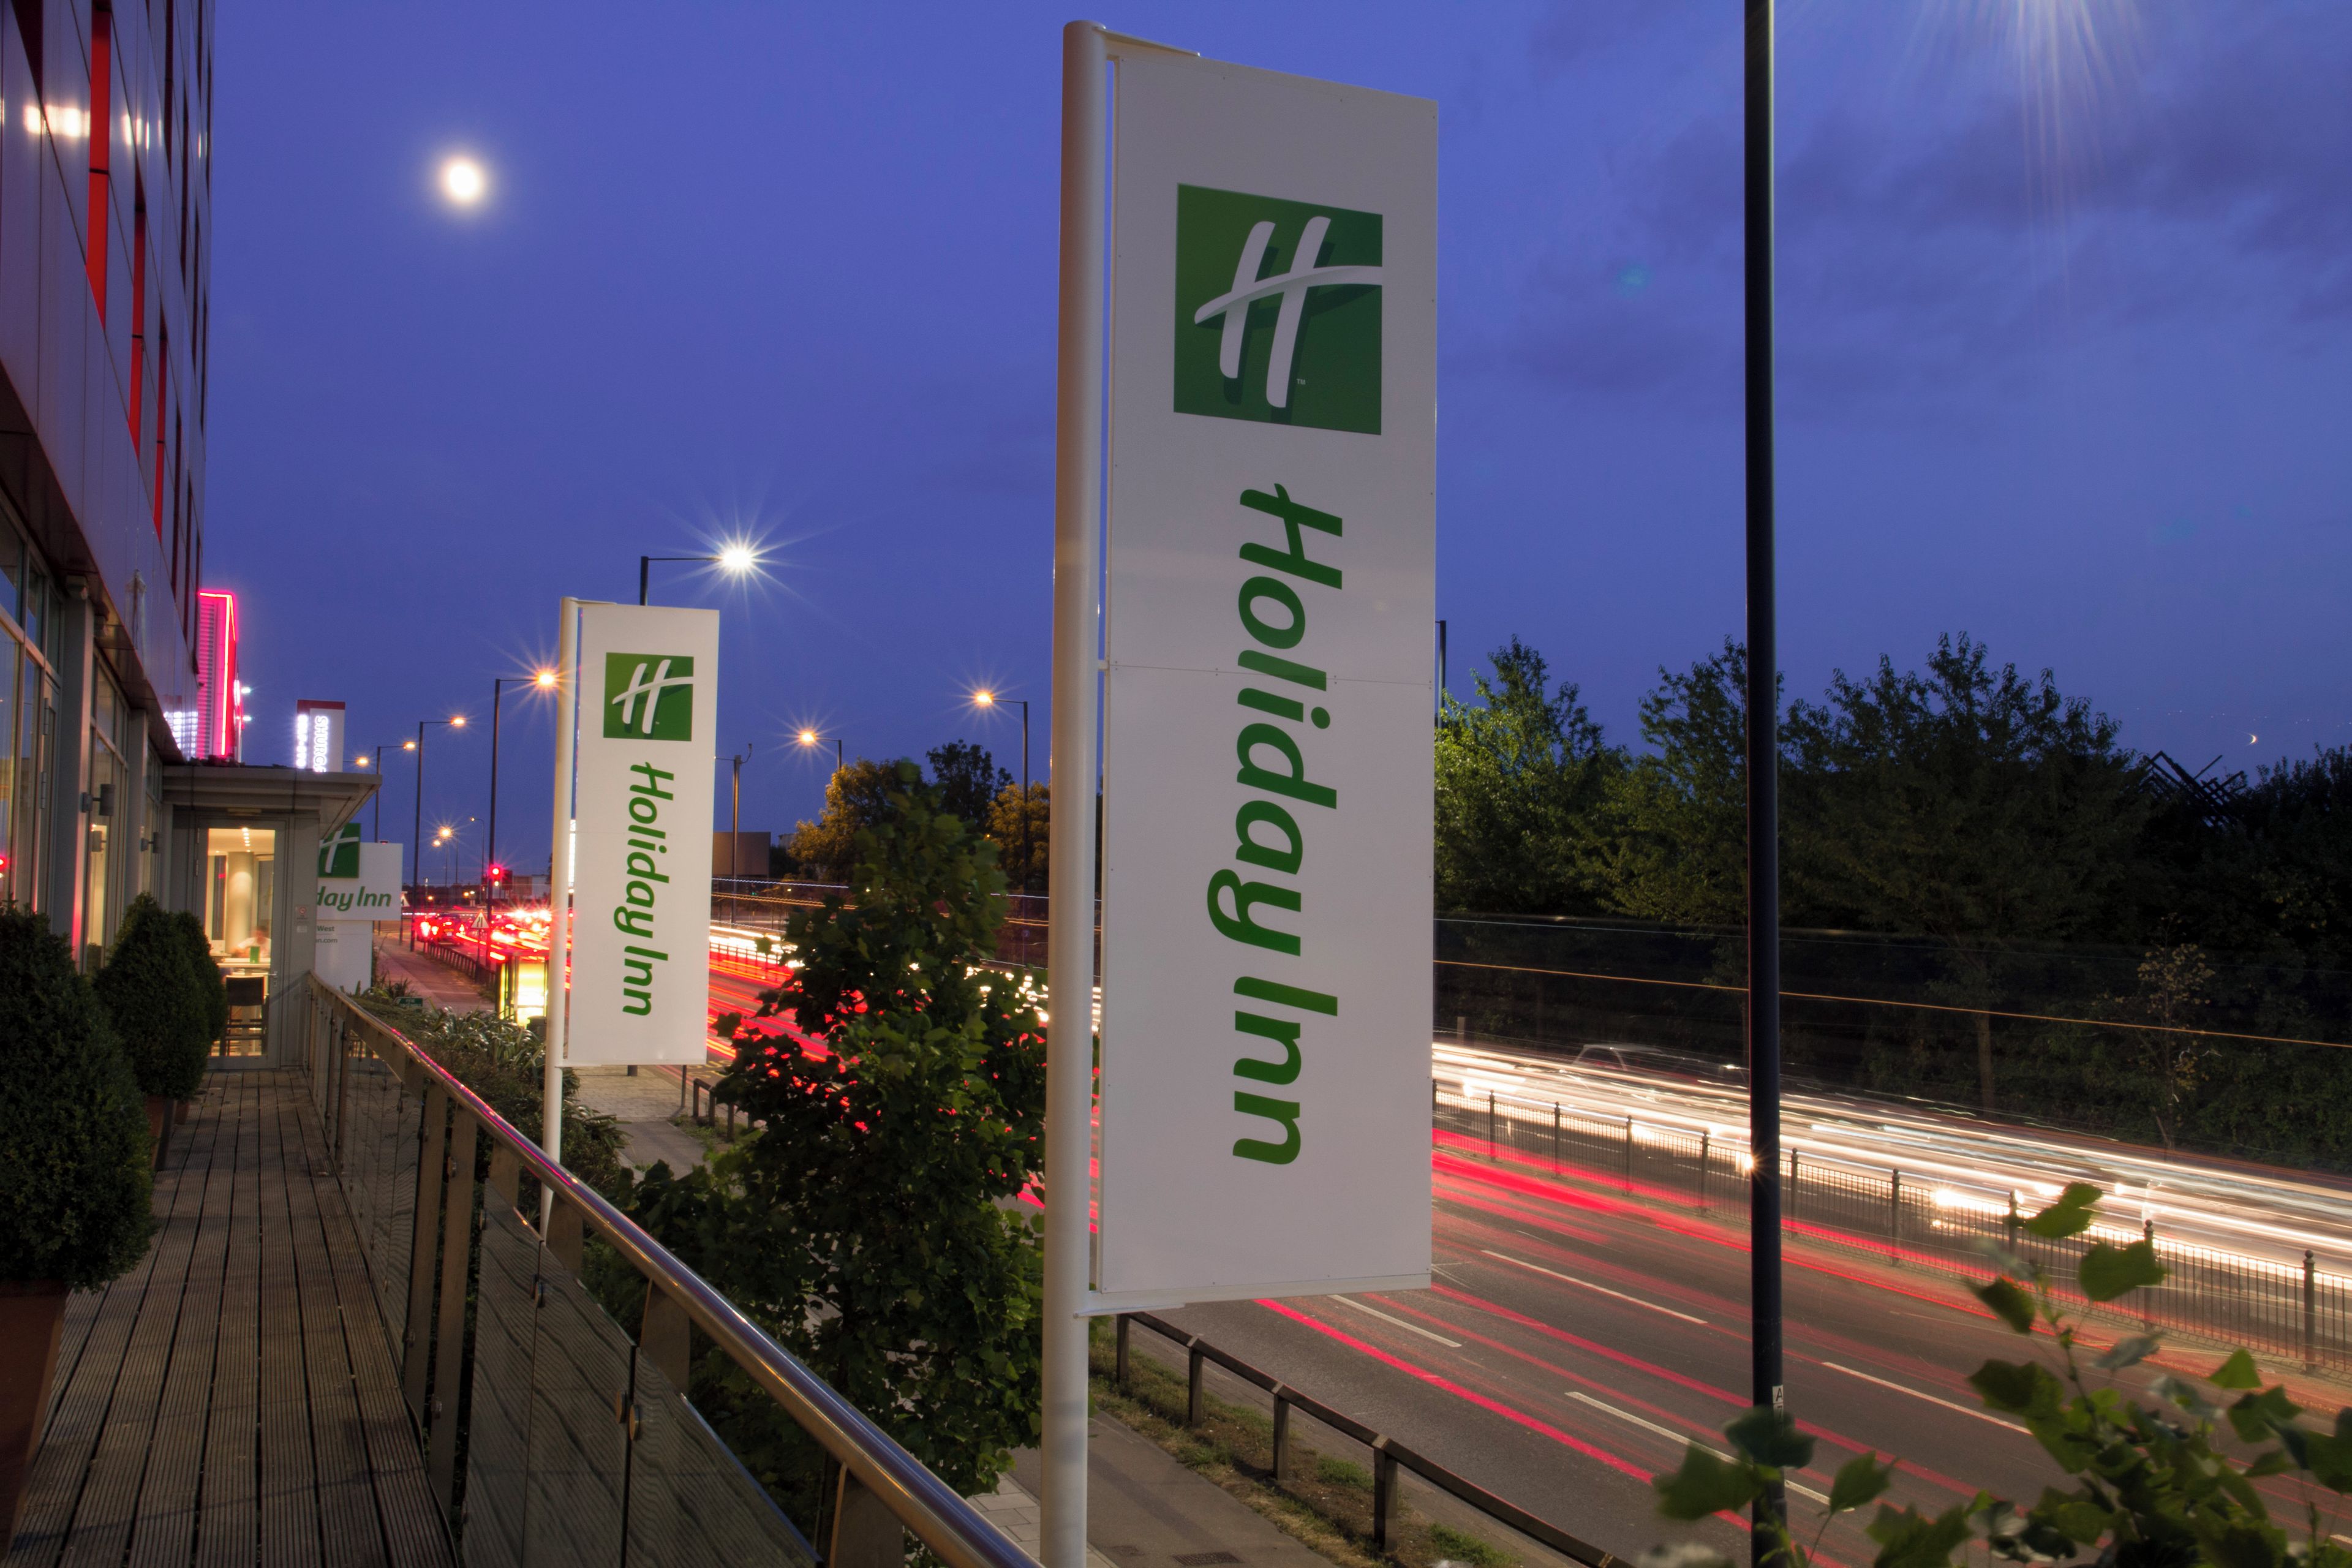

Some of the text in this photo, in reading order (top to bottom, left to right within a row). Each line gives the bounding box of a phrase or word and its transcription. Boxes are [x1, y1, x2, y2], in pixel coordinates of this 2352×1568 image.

[356, 886, 391, 907] Inn
[613, 763, 674, 1016] Holiday Inn
[1207, 484, 1343, 1164] Holiday Inn
